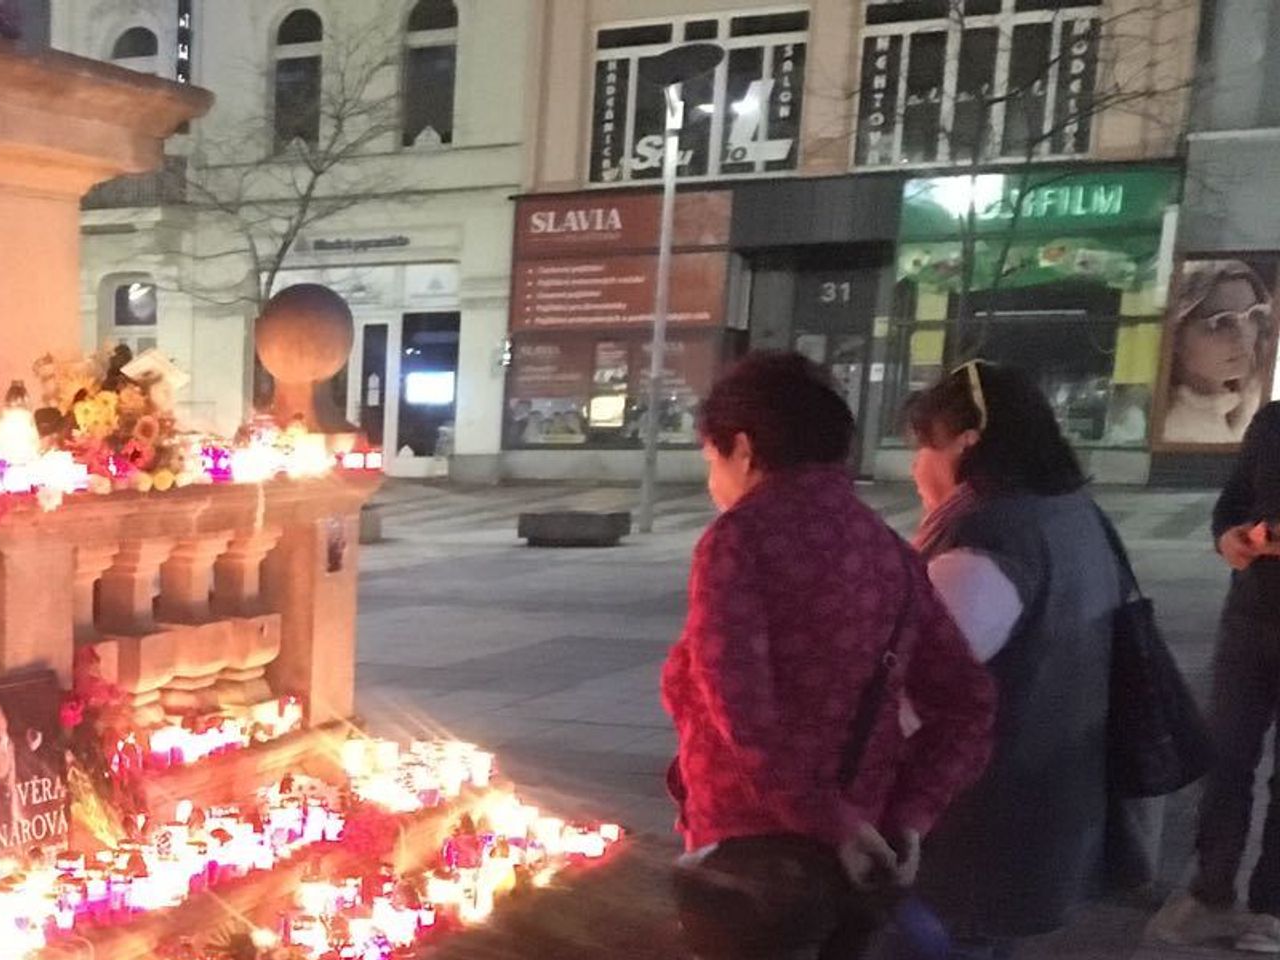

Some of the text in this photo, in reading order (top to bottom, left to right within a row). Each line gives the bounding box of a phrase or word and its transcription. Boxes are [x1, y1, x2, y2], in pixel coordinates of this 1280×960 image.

[778, 45, 794, 118] SALON
[530, 208, 622, 233] SLAVIA
[821, 281, 851, 303] 31
